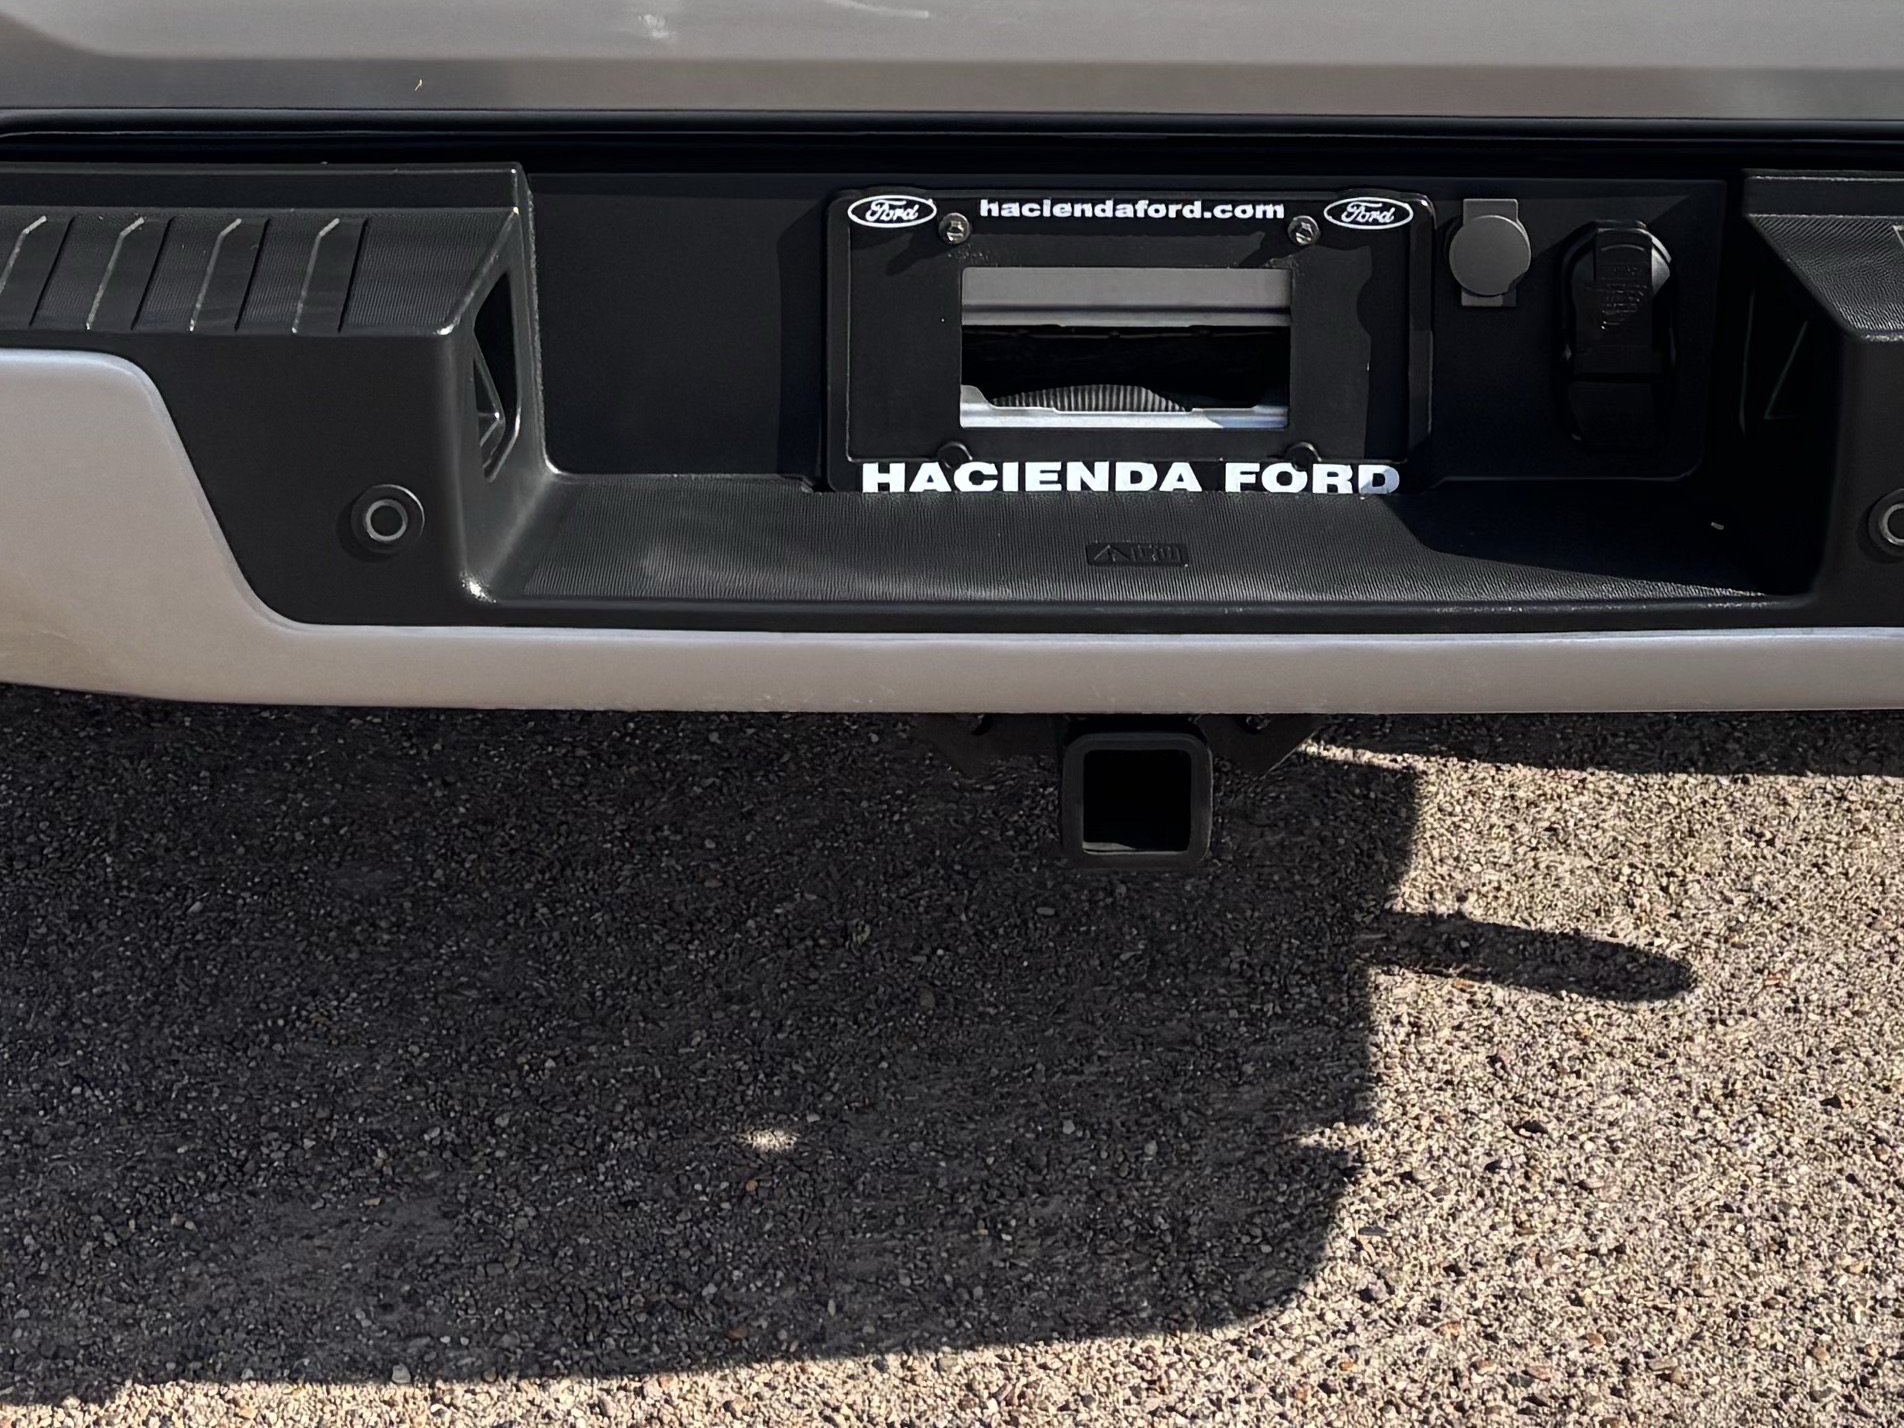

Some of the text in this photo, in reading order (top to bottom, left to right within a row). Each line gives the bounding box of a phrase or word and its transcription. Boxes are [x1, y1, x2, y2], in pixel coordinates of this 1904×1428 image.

[865, 199, 920, 222] Ford
[979, 198, 1285, 220] haciendaford.com
[1341, 201, 1396, 223] Ford
[861, 461, 1400, 495] HACIENDA FORD
